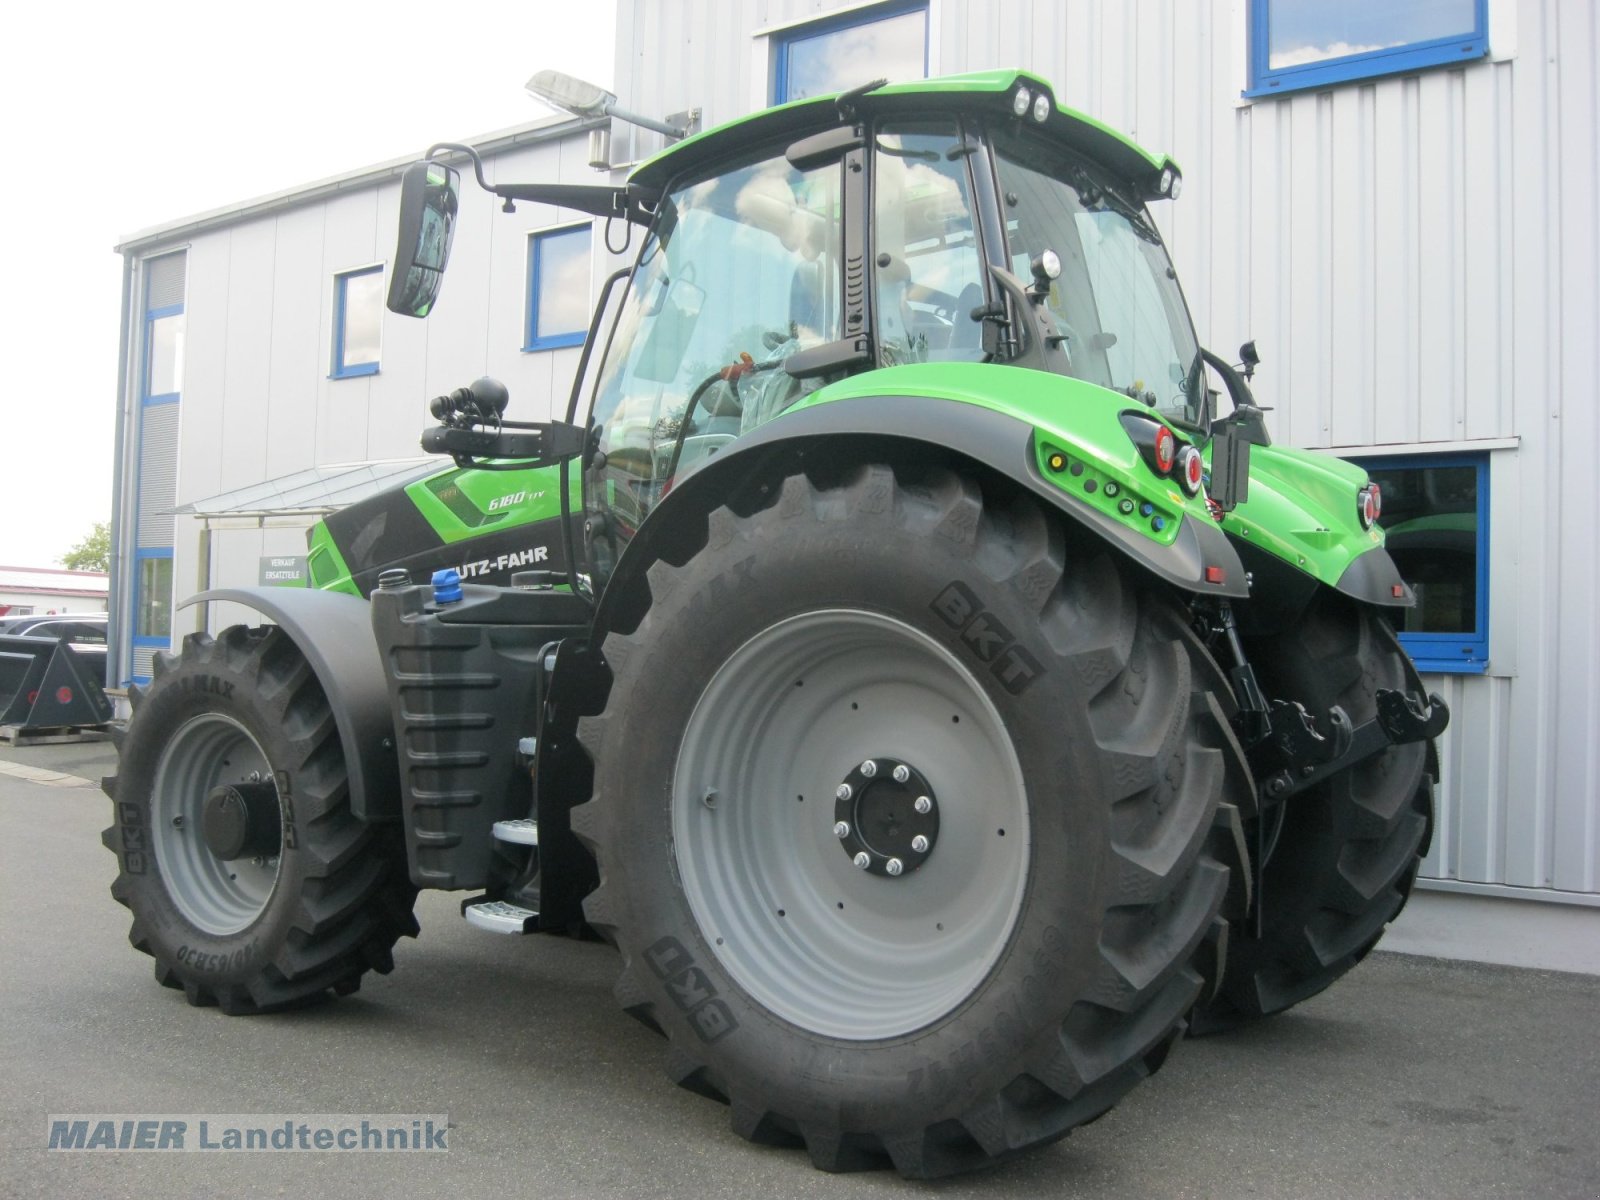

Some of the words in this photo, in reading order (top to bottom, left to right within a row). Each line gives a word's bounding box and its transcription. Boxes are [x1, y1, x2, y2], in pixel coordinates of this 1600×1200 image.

[489, 491, 526, 511] 6180
[265, 570, 300, 579] ERSATZTEILE
[271, 558, 296, 568] VERKAUF
[440, 546, 549, 580] UTZ-FAHR
[929, 580, 1044, 692] BKT
[119, 801, 146, 875] BKT
[642, 937, 738, 1044] BKT
